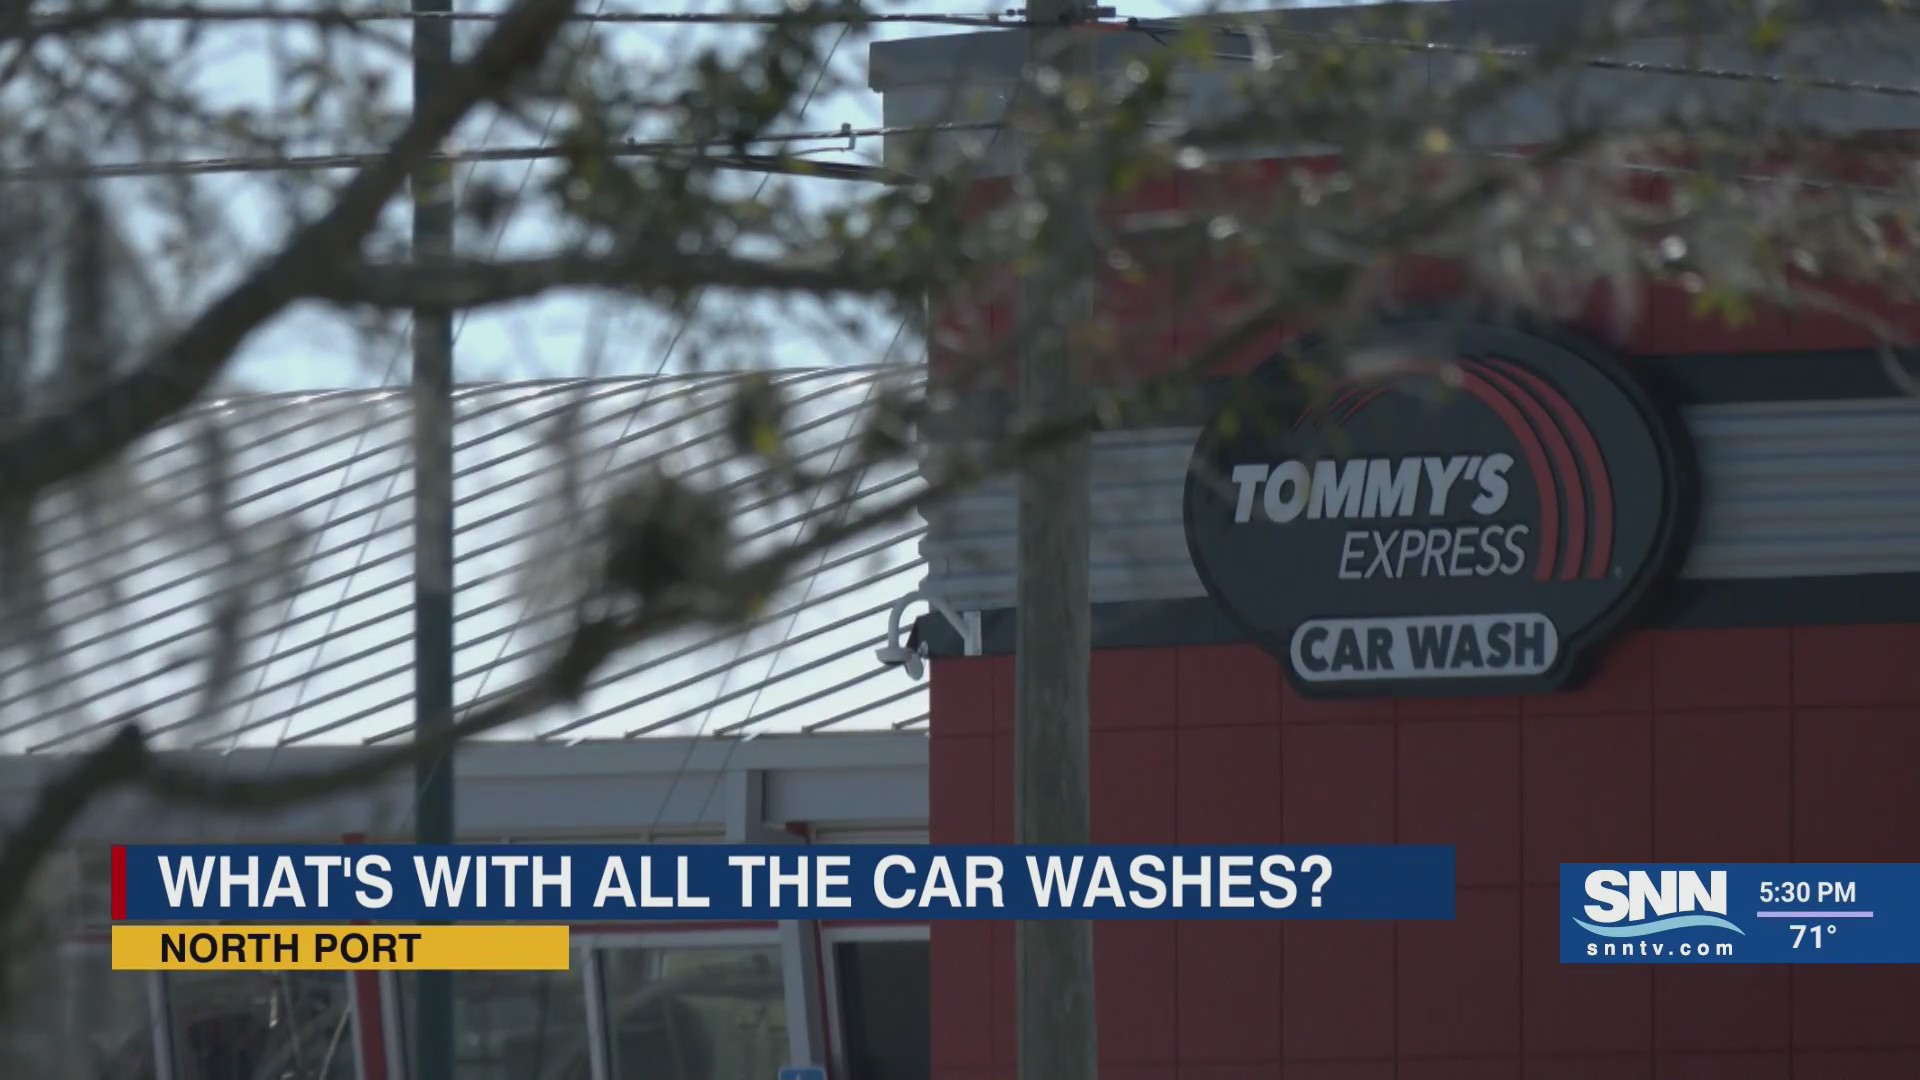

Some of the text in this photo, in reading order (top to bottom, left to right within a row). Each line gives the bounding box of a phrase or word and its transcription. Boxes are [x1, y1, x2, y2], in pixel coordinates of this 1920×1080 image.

[1231, 453, 1515, 523] TOMMY'S
[1338, 525, 1529, 579] EXPRESS
[1300, 621, 1545, 673] CAR WASH
